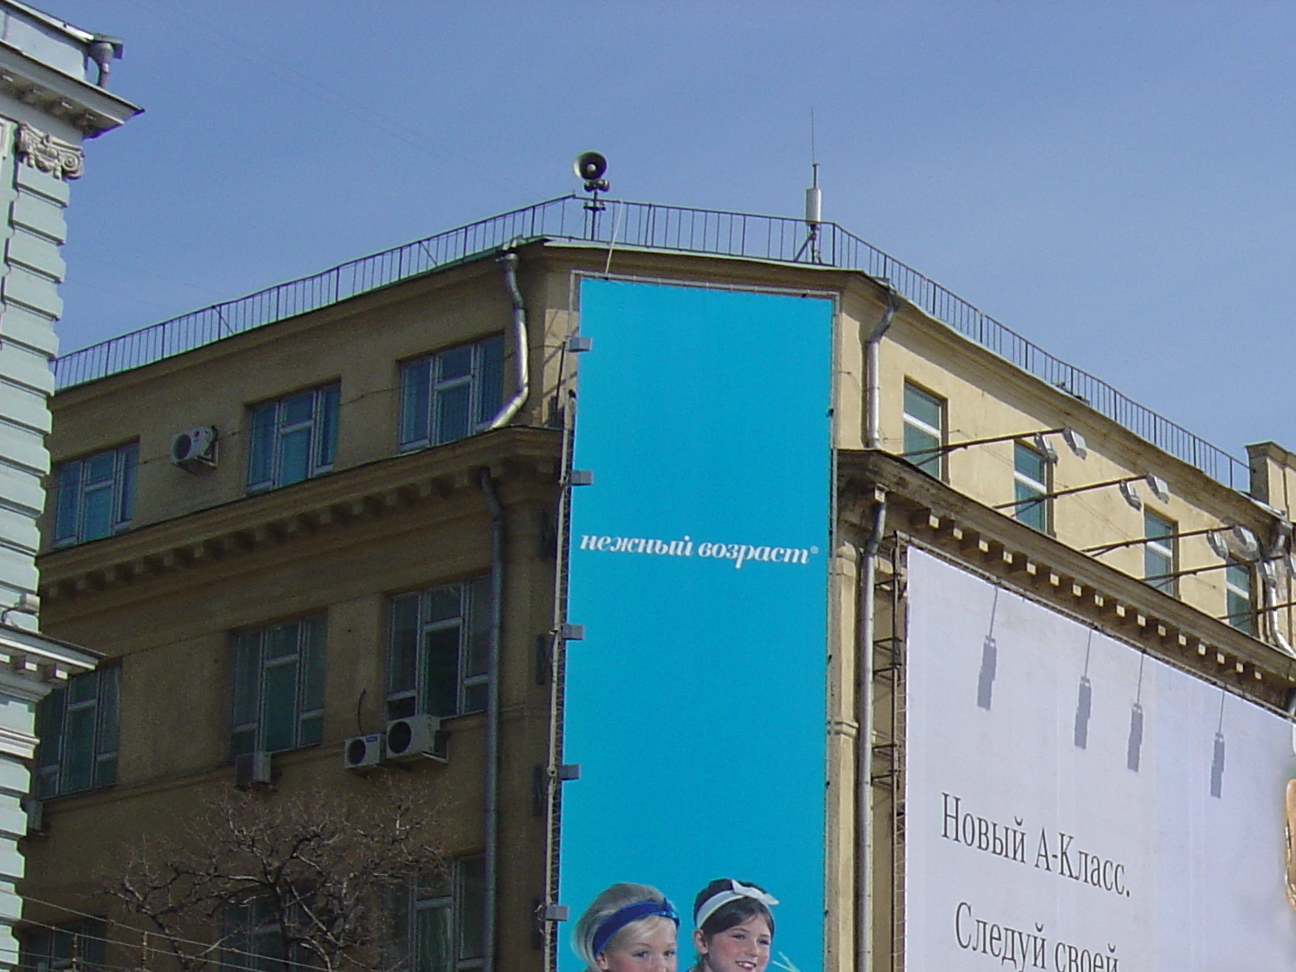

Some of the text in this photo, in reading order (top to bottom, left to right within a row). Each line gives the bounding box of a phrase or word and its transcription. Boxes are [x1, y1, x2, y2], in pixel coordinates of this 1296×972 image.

[580, 534, 693, 557] нежный
[941, 791, 1130, 898] Новый А-Класс.
